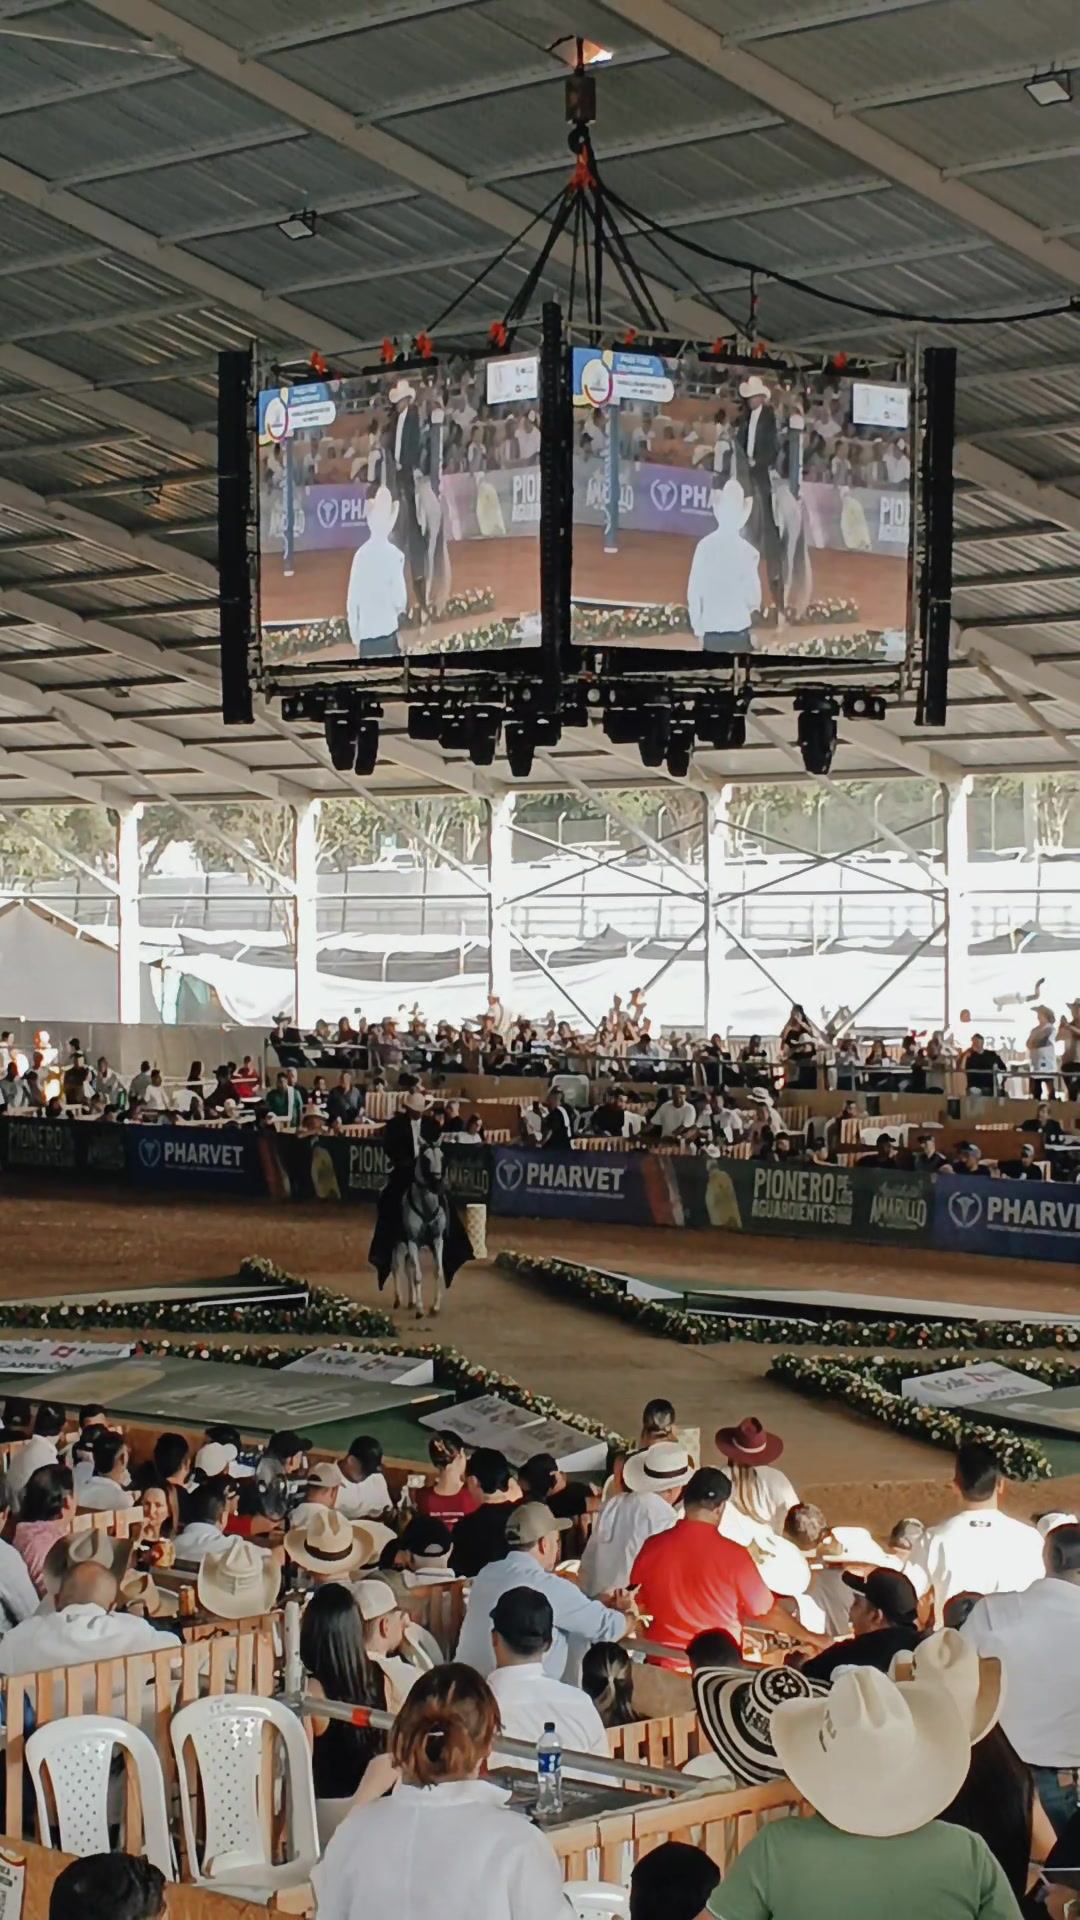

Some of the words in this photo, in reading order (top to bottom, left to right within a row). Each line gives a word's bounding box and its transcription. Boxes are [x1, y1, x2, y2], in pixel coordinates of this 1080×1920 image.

[880, 496, 909, 526] PIO
[164, 1141, 244, 1167] PHARVET
[526, 1162, 625, 1191] PHARVET
[753, 1167, 835, 1204] PIONERO
[751, 1198, 836, 1224] AGUARDIENTES
[869, 1194, 927, 1227] AMARILLO
